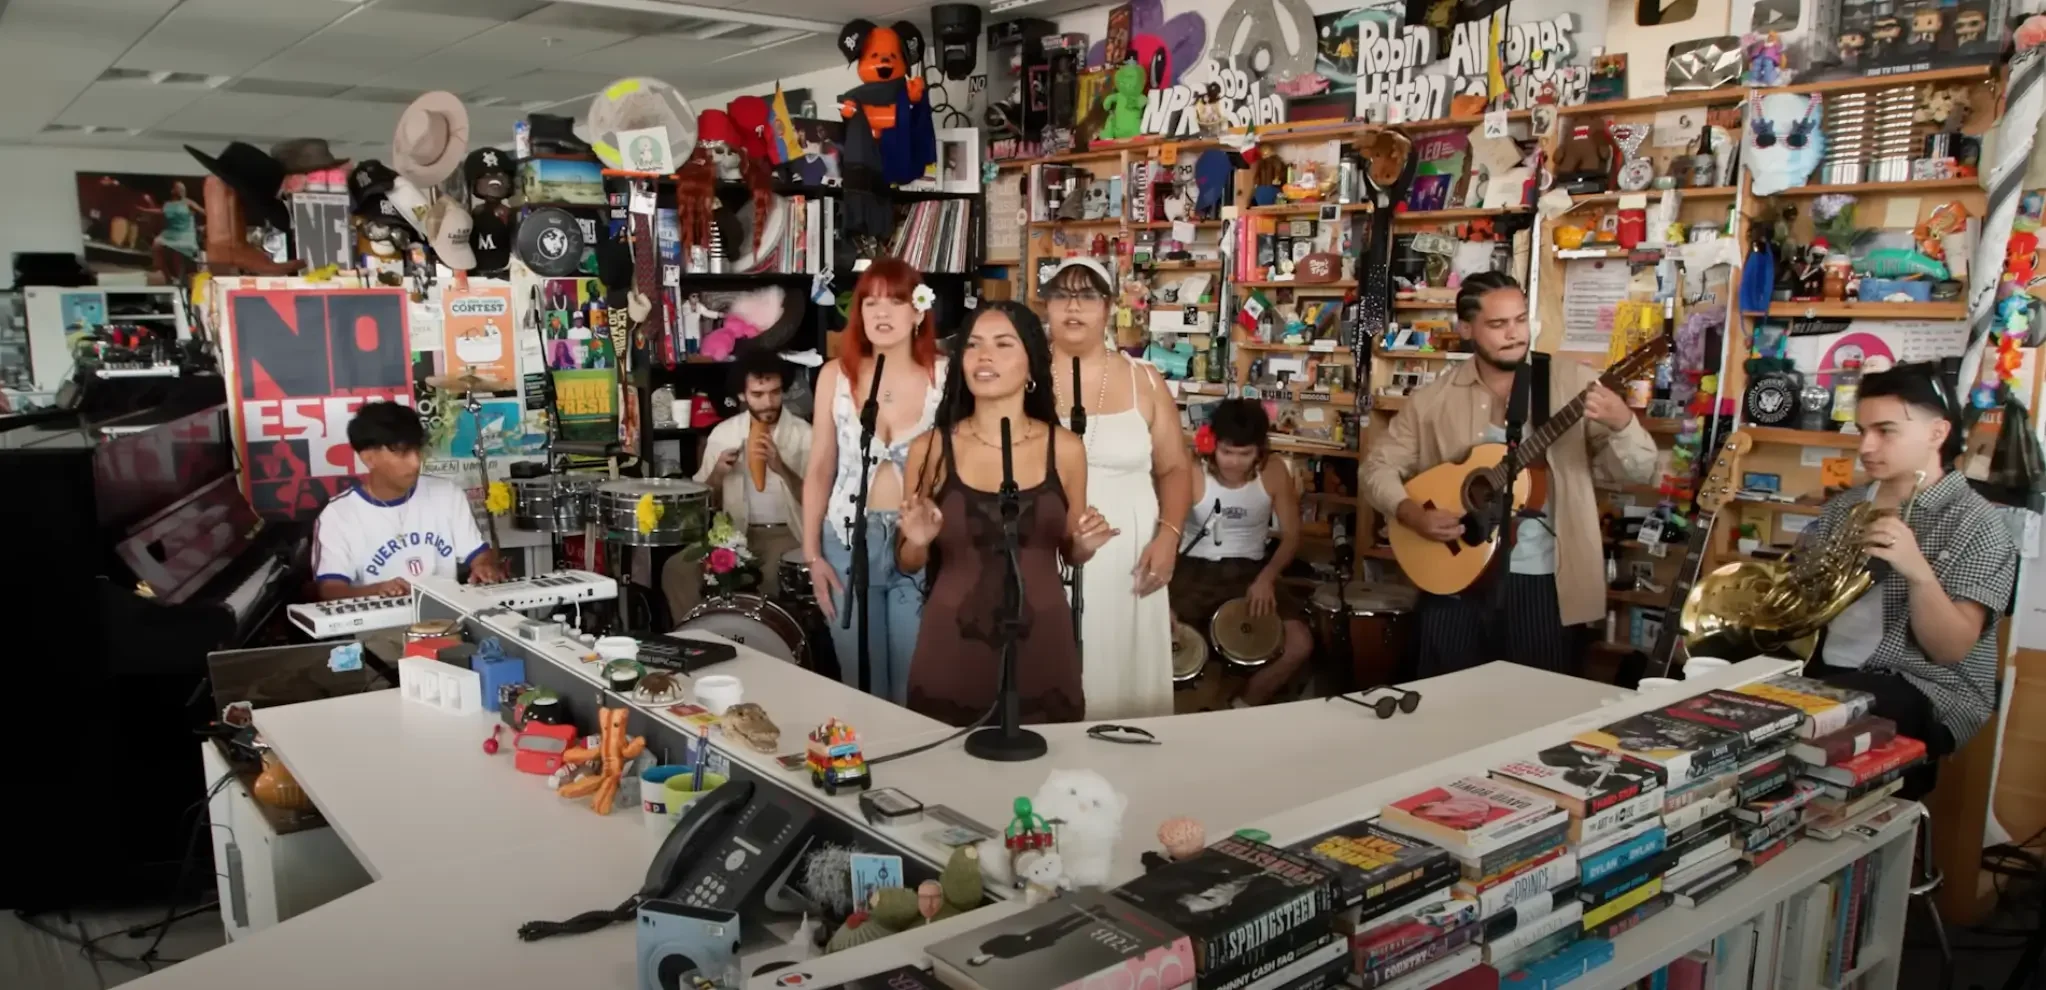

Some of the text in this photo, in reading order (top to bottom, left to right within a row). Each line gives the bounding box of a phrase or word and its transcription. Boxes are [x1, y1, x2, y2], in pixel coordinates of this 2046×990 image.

[1358, 16, 1431, 75] Robin
[1449, 13, 1573, 82] All ongs
[970, 76, 986, 92] NO
[1208, 53, 1249, 100] Bob
[1355, 65, 1447, 124] Hilton
[1221, 80, 1284, 129] Boilen
[451, 303, 505, 313] CONTEST
[234, 294, 407, 399] NO
[242, 394, 410, 443] ESE
[365, 530, 453, 577] PUERTO RICO
[1514, 866, 1549, 900] PRINCE
[1228, 889, 1317, 961] SPRINGSTEEN
[1251, 960, 1276, 979] CASH
[1276, 952, 1296, 968] FAQ
[1384, 950, 1429, 981] COUNTRY
